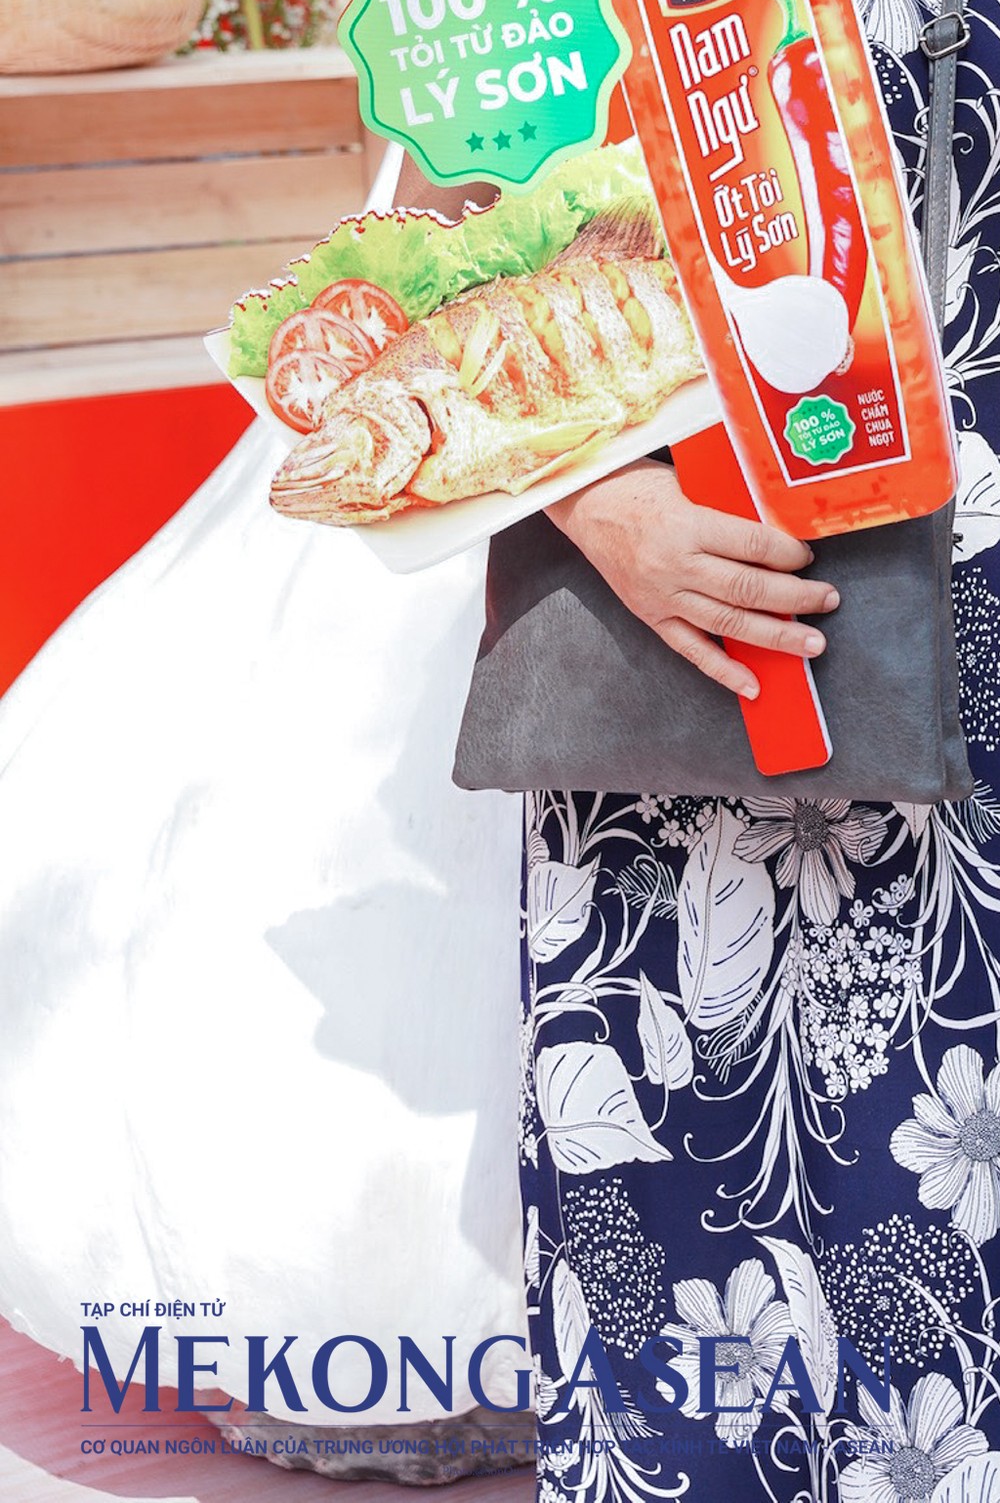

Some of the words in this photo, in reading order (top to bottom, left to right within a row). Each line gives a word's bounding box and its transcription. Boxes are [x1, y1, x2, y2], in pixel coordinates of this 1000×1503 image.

[389, 35, 445, 72] TỎI
[450, 23, 494, 60] TỪ
[501, 8, 574, 49] ĐẢO
[669, 13, 750, 89] Nam
[400, 68, 460, 127] LÝ
[475, 51, 588, 111] SƠN
[687, 73, 759, 182] Ngư
[740, 168, 783, 213] Tỏi
[752, 212, 799, 254] Sơn
[857, 389, 885, 405] NƯỚC
[861, 402, 889, 420] CHẤM
[793, 415, 820, 433] 100
[820, 408, 836, 422] %
[865, 418, 893, 434] CHUA
[801, 437, 817, 452] LÝ
[819, 428, 846, 446] SƠN
[868, 431, 895, 447] NGỌT
